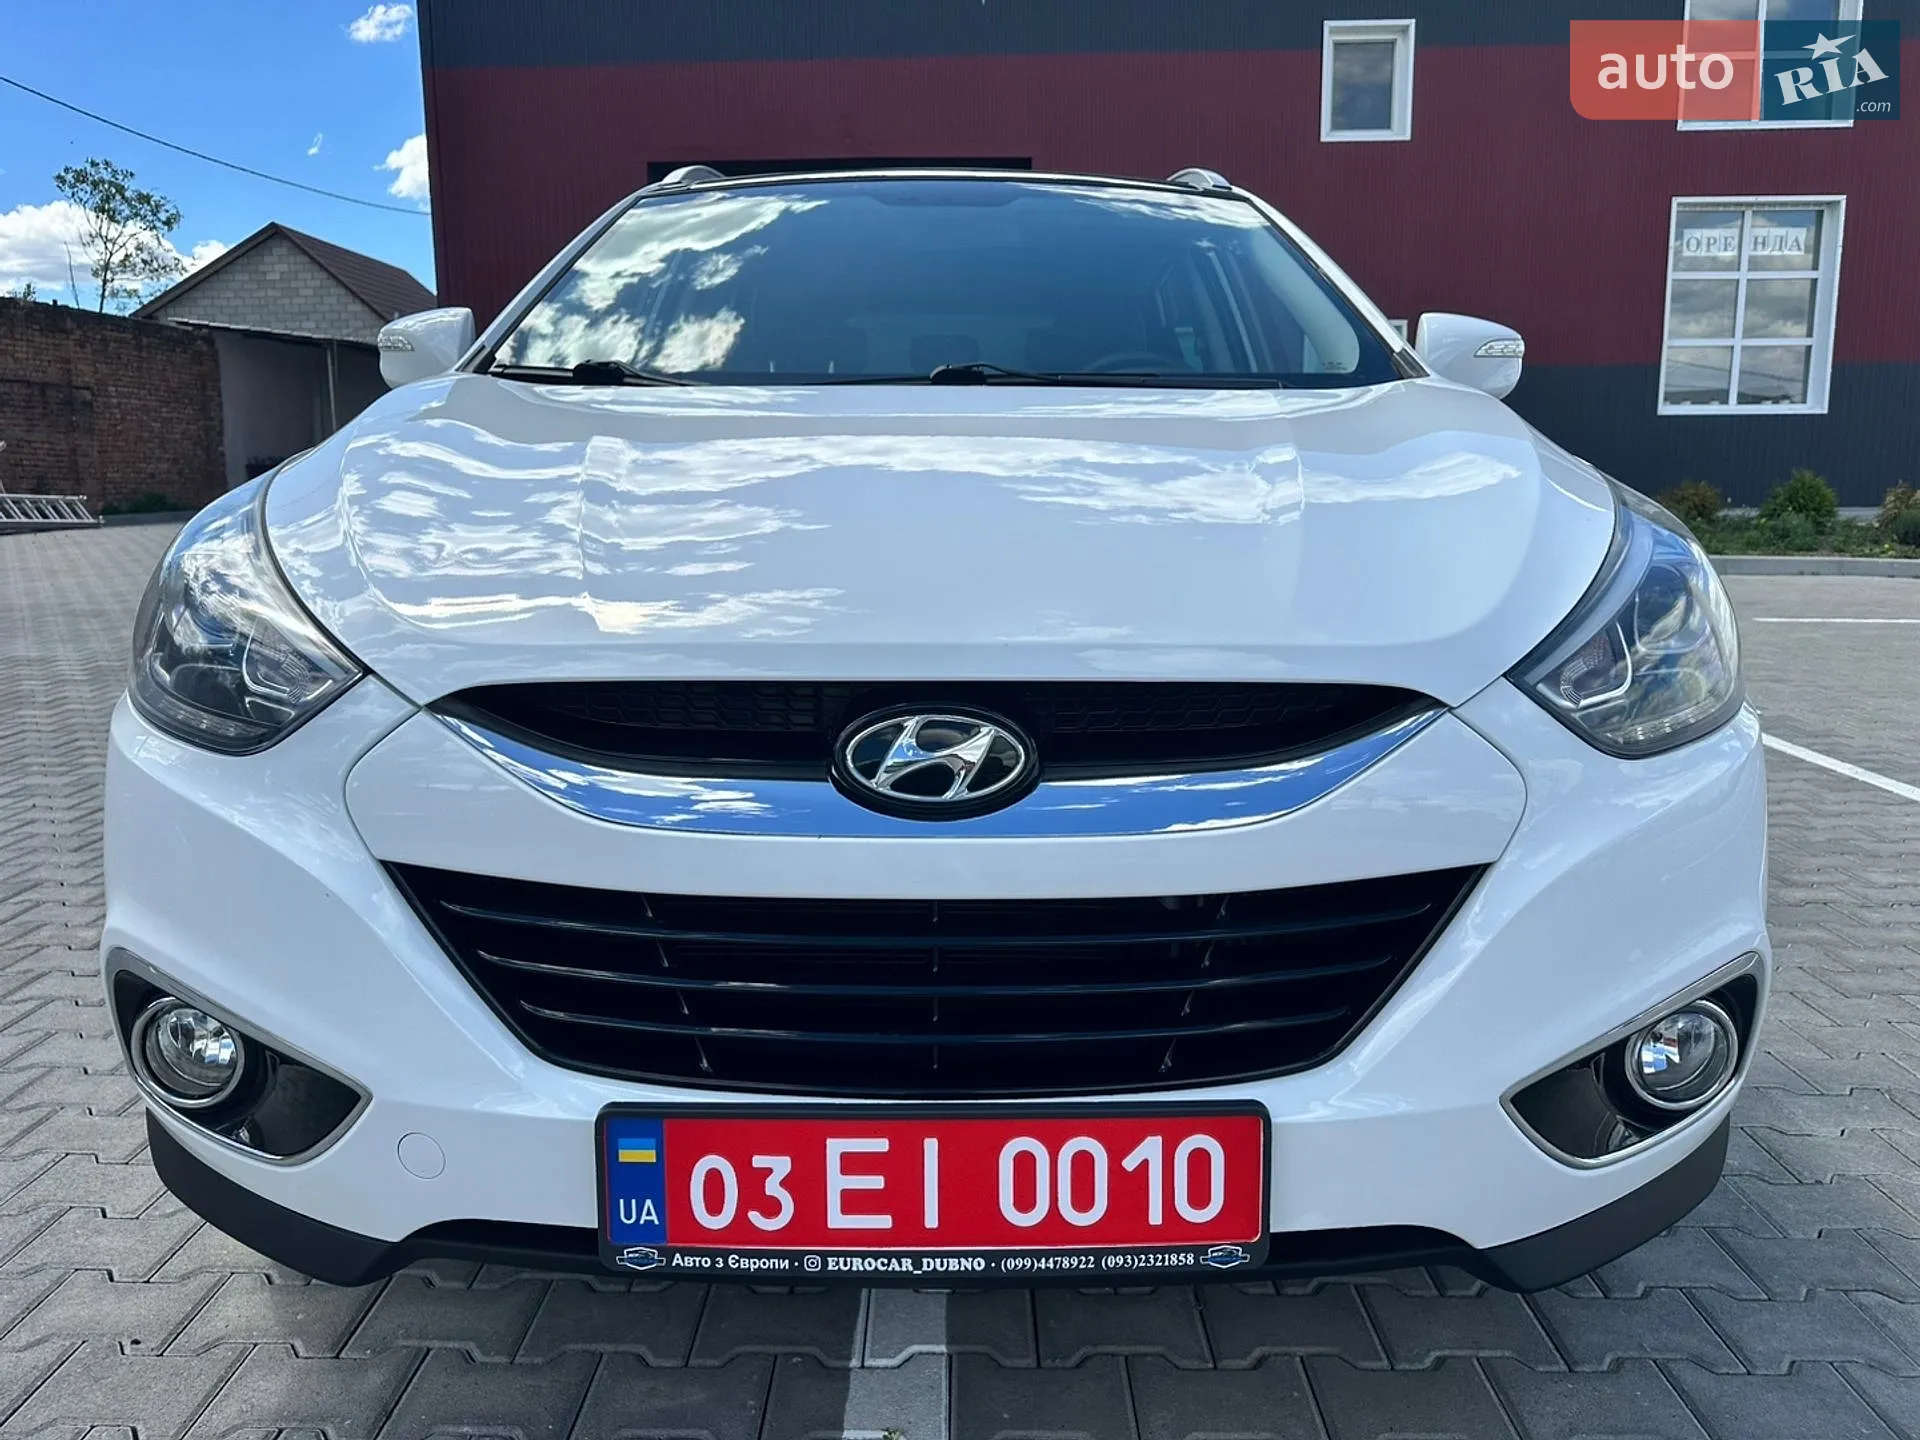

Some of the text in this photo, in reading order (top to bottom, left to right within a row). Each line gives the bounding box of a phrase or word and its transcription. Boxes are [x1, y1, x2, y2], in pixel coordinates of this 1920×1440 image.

[689, 1154, 795, 1231] 03
[998, 1133, 1226, 1227] 0010
[618, 1198, 660, 1225] UA
[671, 1252, 711, 1269] Авто
[727, 1254, 790, 1272] Європи
[826, 1256, 986, 1274] EUROCAR_DUBNO
[1000, 1256, 1095, 1273] (099)4478922
[1101, 1253, 1195, 1271] (093)2321858
